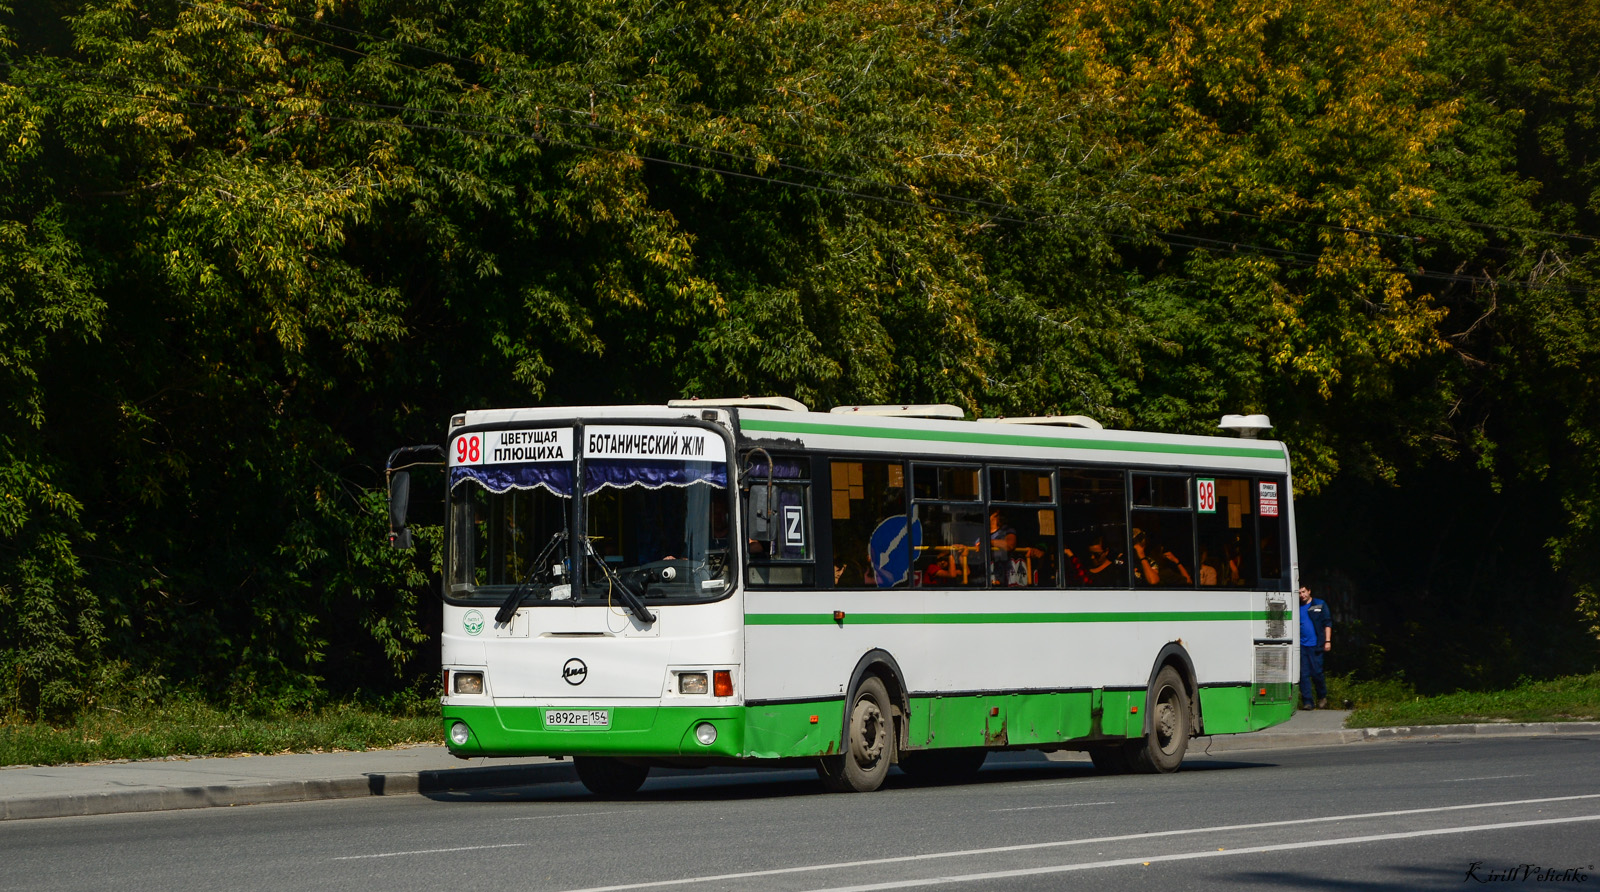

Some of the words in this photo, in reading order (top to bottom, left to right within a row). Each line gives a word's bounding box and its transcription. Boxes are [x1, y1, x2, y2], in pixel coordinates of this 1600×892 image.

[457, 435, 480, 463] 98
[500, 430, 558, 447] ЦВЕТУЩАЯ
[589, 430, 679, 455] БОТАНИЧЕСКИЙ
[682, 441, 705, 456] Ж/М
[494, 445, 564, 462] ПЛЮЩИХА
[1199, 481, 1214, 510] 98
[786, 511, 801, 540] Z
[549, 712, 588, 724] В892РЕ
[590, 711, 607, 721] 154
